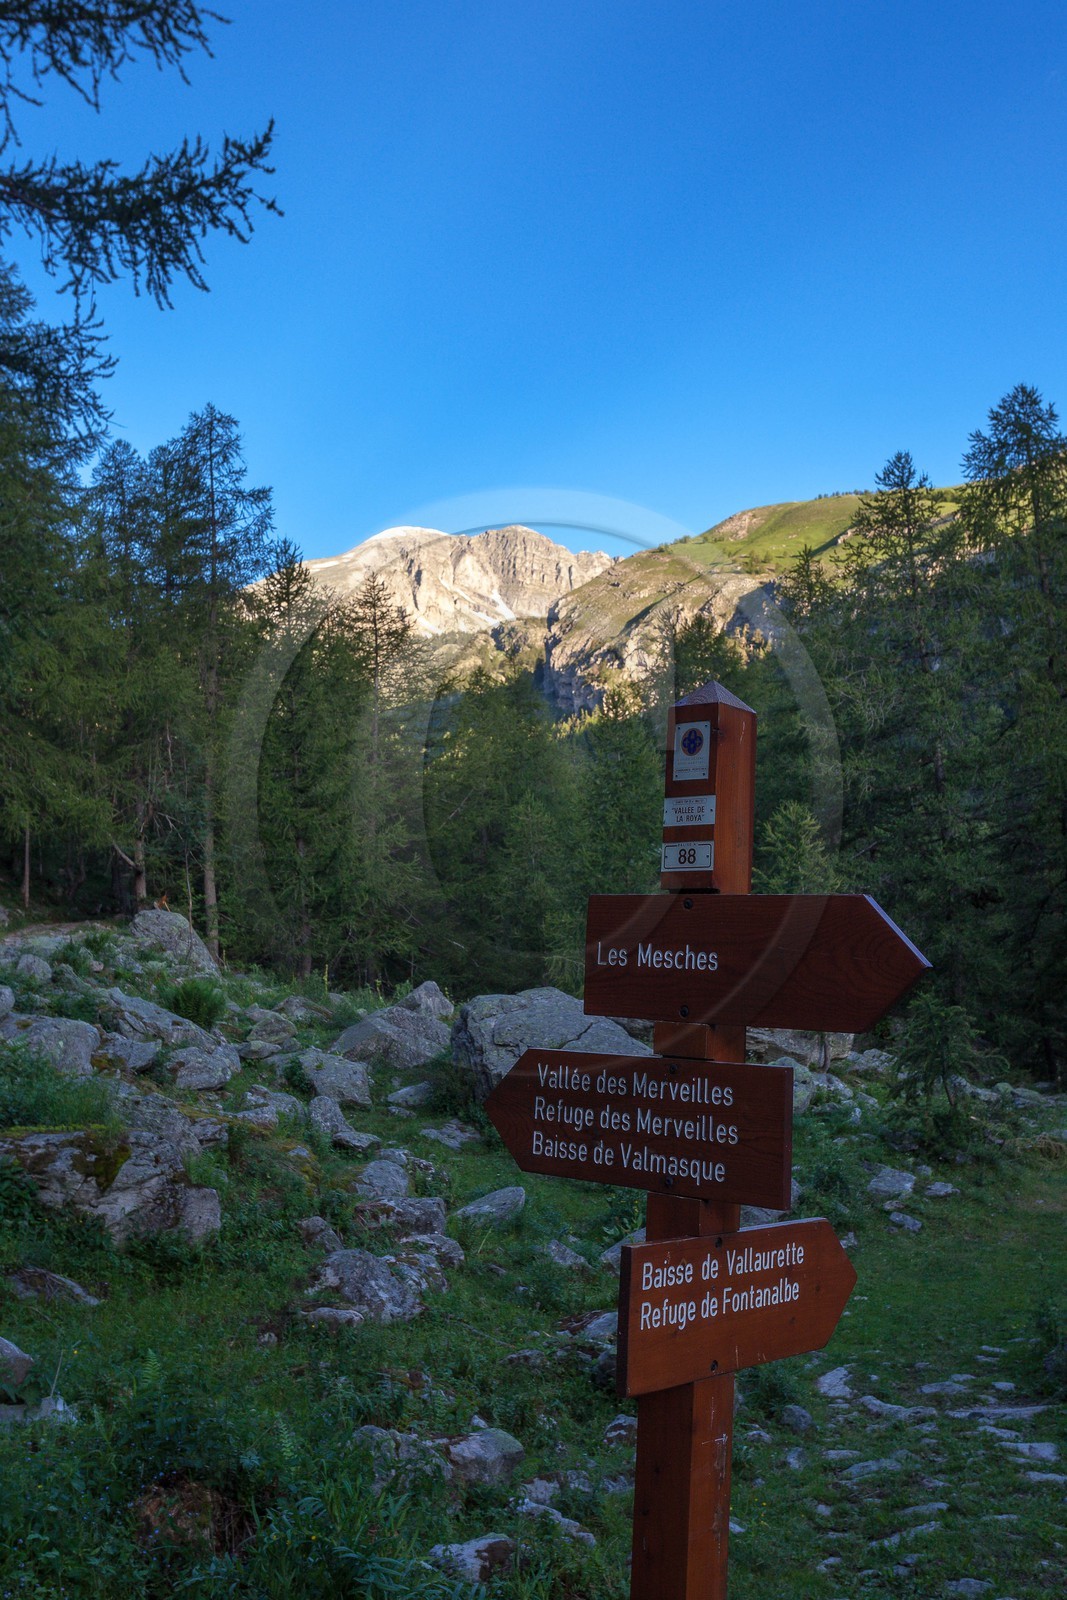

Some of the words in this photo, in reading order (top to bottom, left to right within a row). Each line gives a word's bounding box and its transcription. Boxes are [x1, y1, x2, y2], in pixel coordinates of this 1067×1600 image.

[676, 815, 684, 823] LA
[697, 805, 705, 813] DE
[678, 848, 697, 865] 88
[597, 941, 628, 967] Les
[637, 943, 719, 971] Mesches
[537, 1062, 591, 1092] Vallée
[596, 1069, 627, 1096] des
[632, 1071, 734, 1107] Merveilles
[534, 1096, 594, 1132] Refuge
[600, 1104, 631, 1131] des
[636, 1107, 739, 1145] Merveilles
[532, 1130, 588, 1162] Baisse
[593, 1140, 614, 1166] de
[620, 1142, 726, 1186] Valmasque
[641, 1259, 693, 1291] Baisse
[701, 1253, 719, 1280] de
[726, 1242, 804, 1276] Vallaurette
[640, 1298, 696, 1331] Refuge
[701, 1291, 718, 1319] de
[722, 1277, 799, 1314] Fontanalbe
